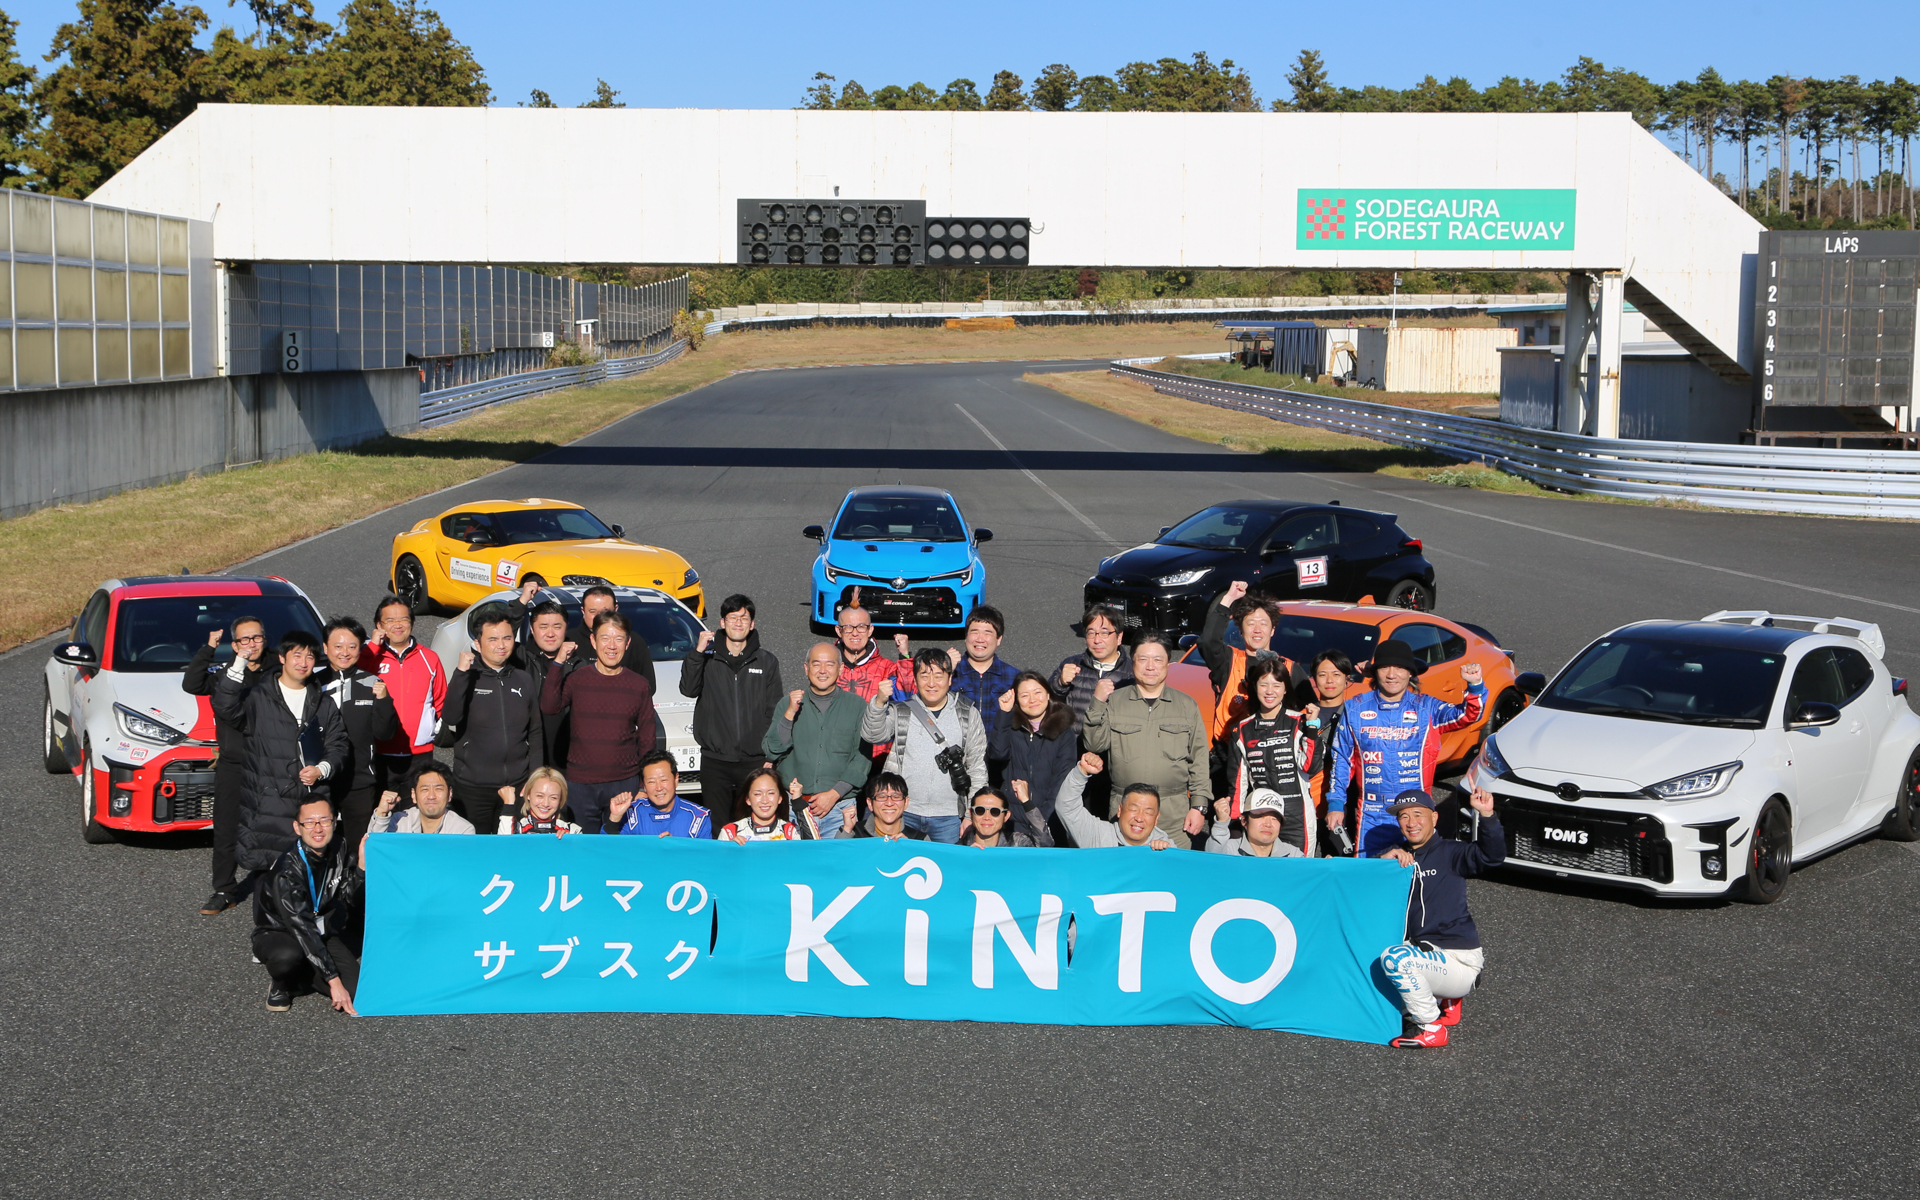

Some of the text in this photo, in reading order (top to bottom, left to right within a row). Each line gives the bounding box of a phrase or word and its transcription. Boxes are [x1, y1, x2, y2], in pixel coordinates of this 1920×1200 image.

[1355, 199, 1500, 218] SODEGAURA
[1354, 221, 1565, 240] FOREST RACEWAY
[1825, 237, 1859, 253] LAPS
[1770, 261, 1777, 278] 1
[1768, 285, 1777, 302] 2
[1767, 310, 1777, 327] 3
[584, 324, 589, 333] 1
[544, 332, 552, 347] 50
[1766, 335, 1775, 352] 4
[286, 332, 299, 371] 100
[1765, 359, 1774, 376] 5
[1764, 384, 1774, 401] 6
[466, 571, 490, 582] experience
[503, 565, 511, 576] 3
[1306, 563, 1319, 575] 13
[1257, 738, 1288, 747] CUSCO
[1363, 751, 1383, 761] OK!
[478, 872, 709, 917] クルマの
[473, 935, 701, 982] サブスク
